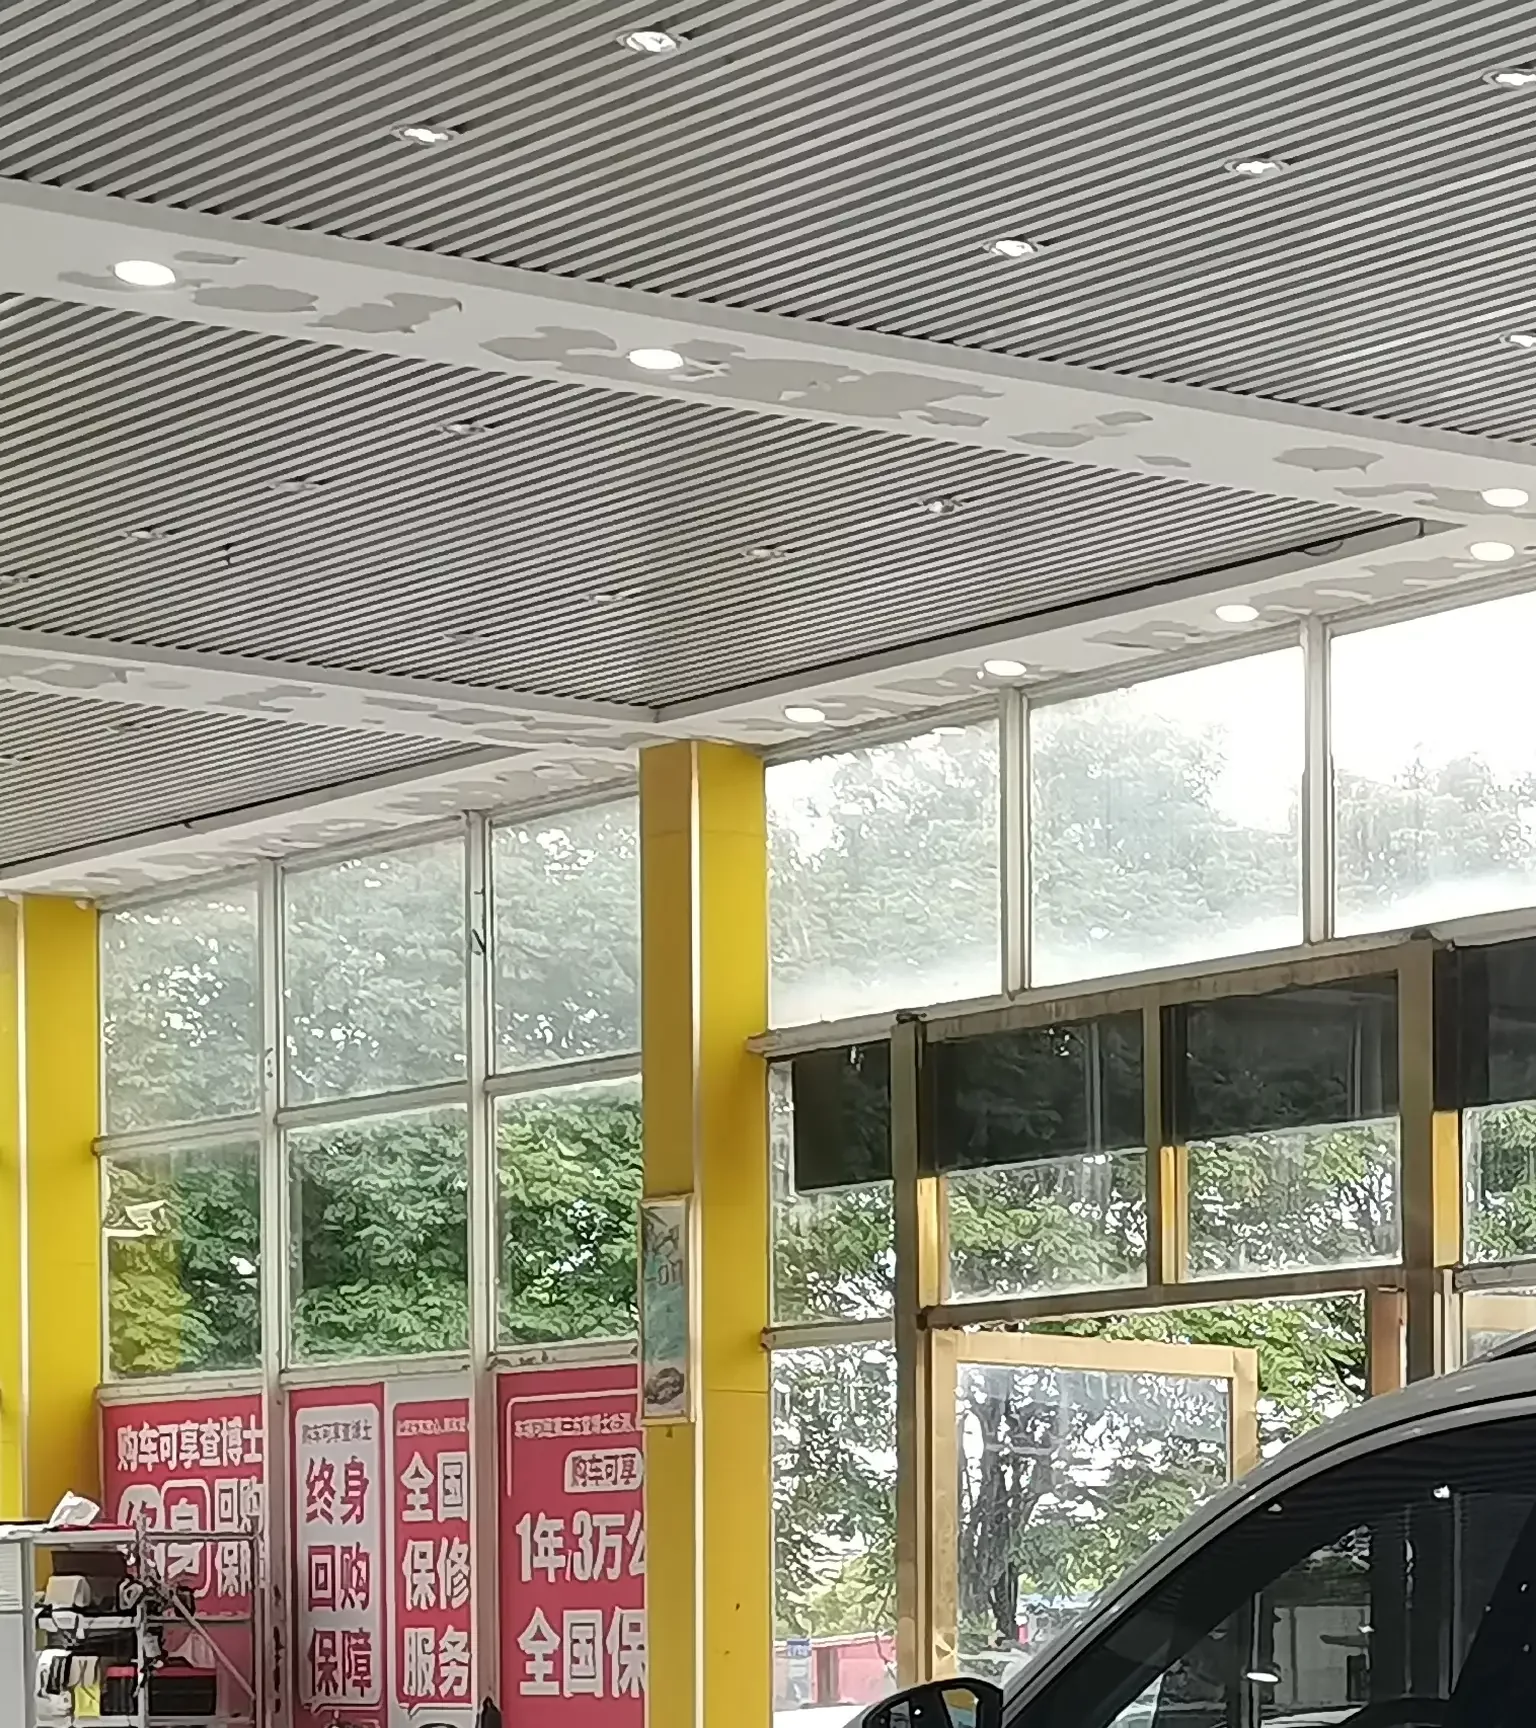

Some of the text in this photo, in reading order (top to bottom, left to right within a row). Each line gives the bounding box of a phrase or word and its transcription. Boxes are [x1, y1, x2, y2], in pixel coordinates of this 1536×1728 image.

[117, 1414, 264, 1473] 购车可享查博士
[571, 1453, 637, 1487] 购车可享
[305, 1455, 370, 1525] 终身
[400, 1451, 467, 1523] 全国
[307, 1541, 370, 1612] 回购
[402, 1537, 469, 1611] 保修
[307, 1627, 372, 1698] 保障
[403, 1624, 470, 1698] 服务
[517, 1606, 645, 1698] 全国保
